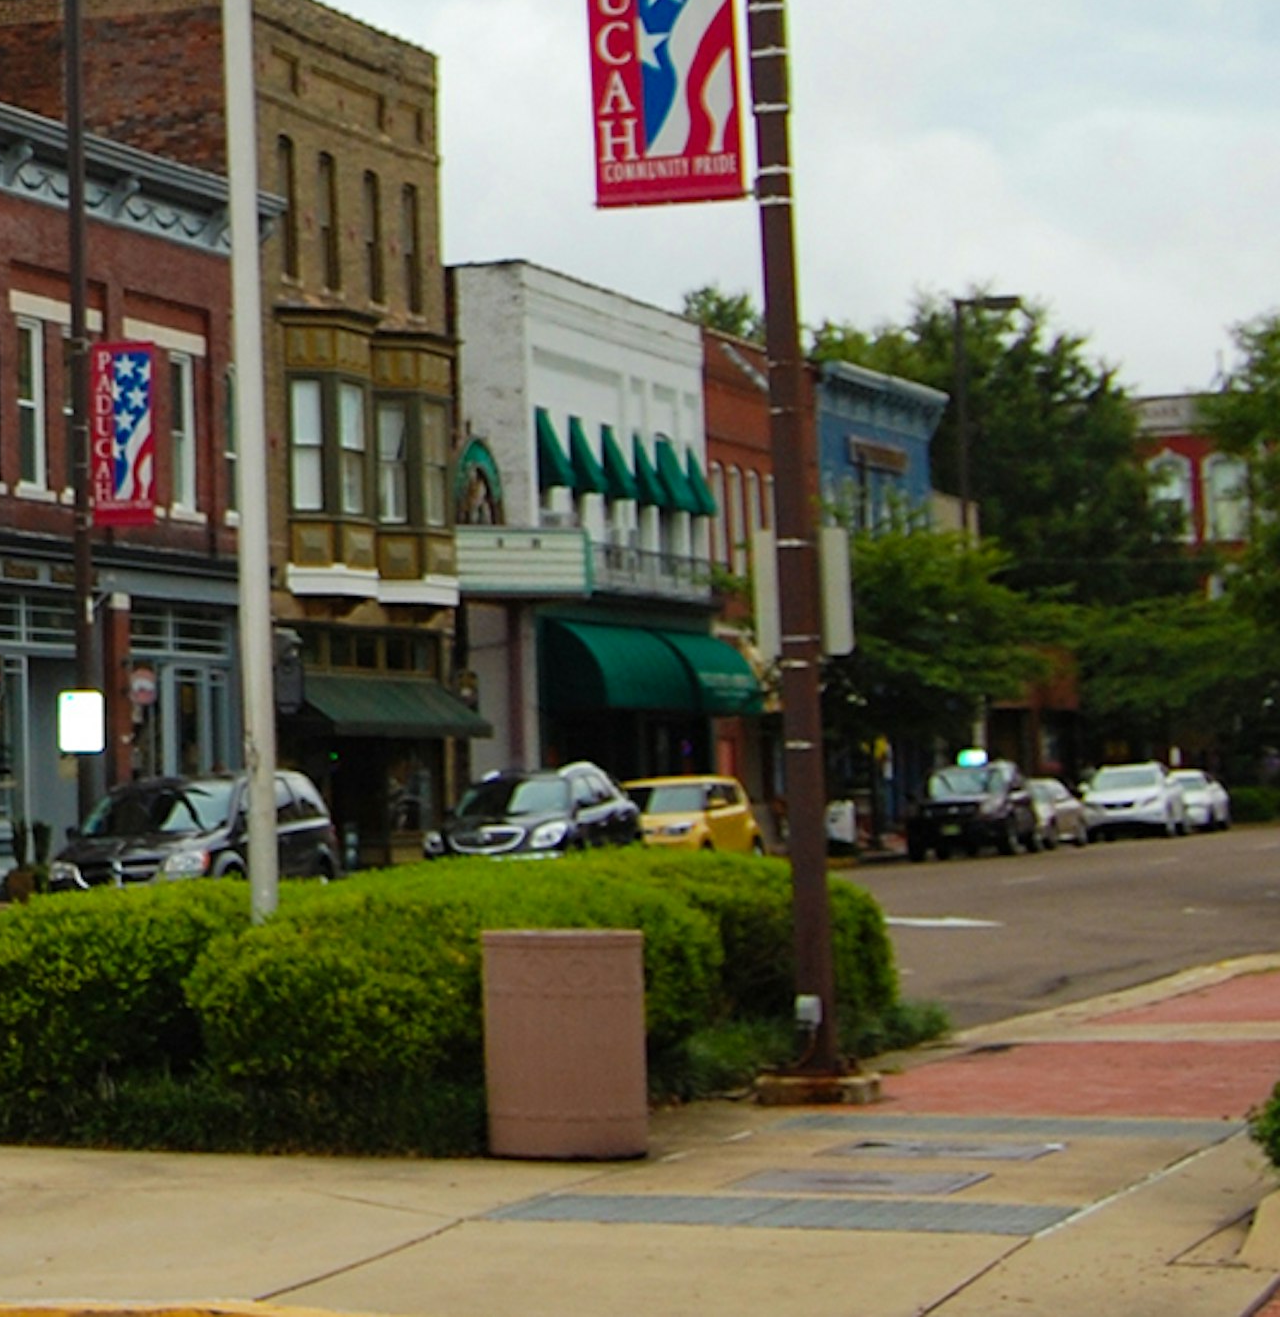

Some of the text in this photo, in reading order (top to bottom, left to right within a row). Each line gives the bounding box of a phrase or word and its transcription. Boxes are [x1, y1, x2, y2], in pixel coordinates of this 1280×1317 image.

[604, 153, 737, 183] COMMUNITY PRIDE
[95, 351, 113, 502] PADUCAH
